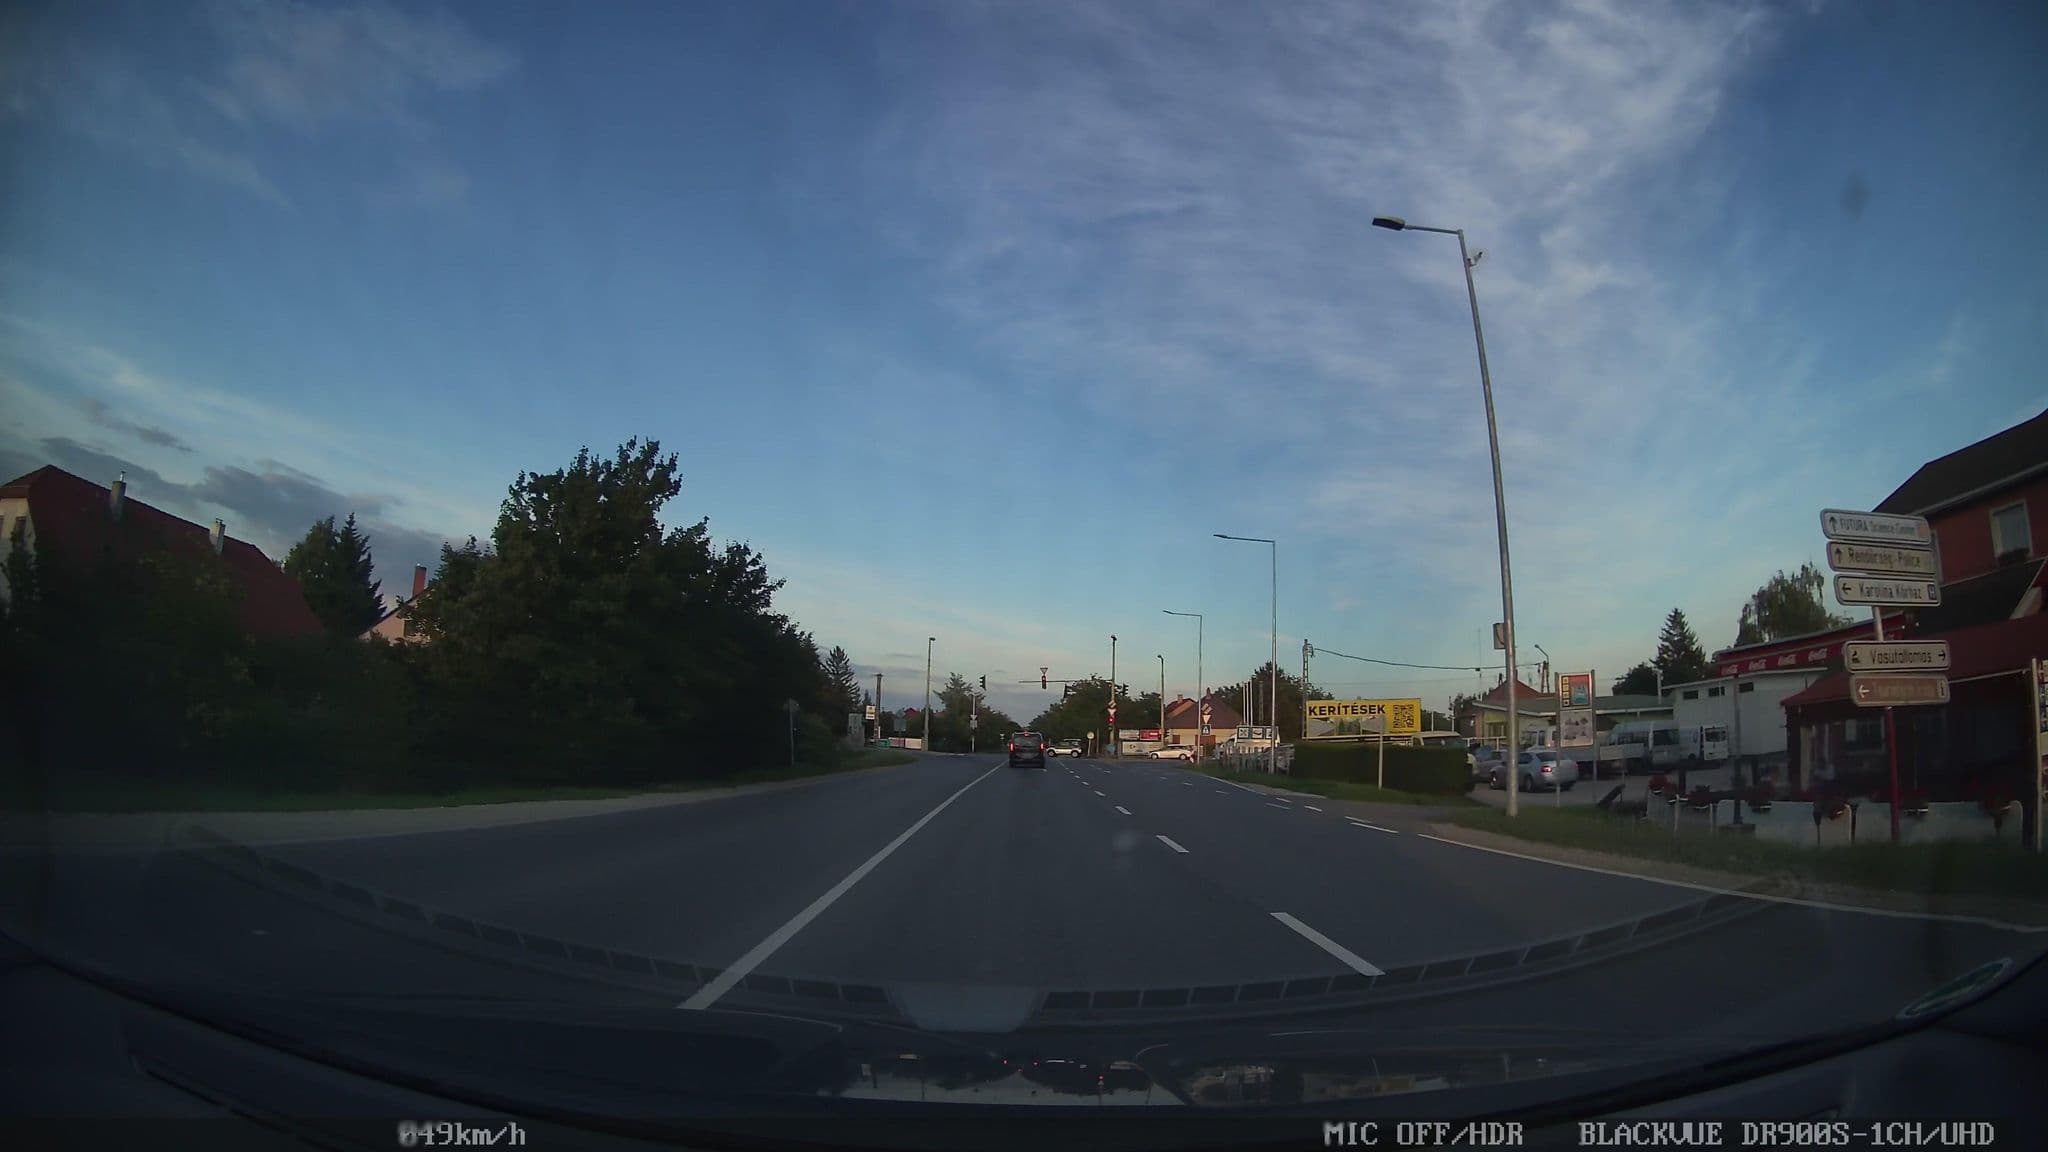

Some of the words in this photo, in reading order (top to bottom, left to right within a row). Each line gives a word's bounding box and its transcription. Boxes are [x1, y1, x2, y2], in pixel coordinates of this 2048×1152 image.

[1839, 518, 1869, 532] FUTURA
[1858, 582, 1894, 599] Karolina
[1308, 702, 1386, 716] KERÍTÉSEK
